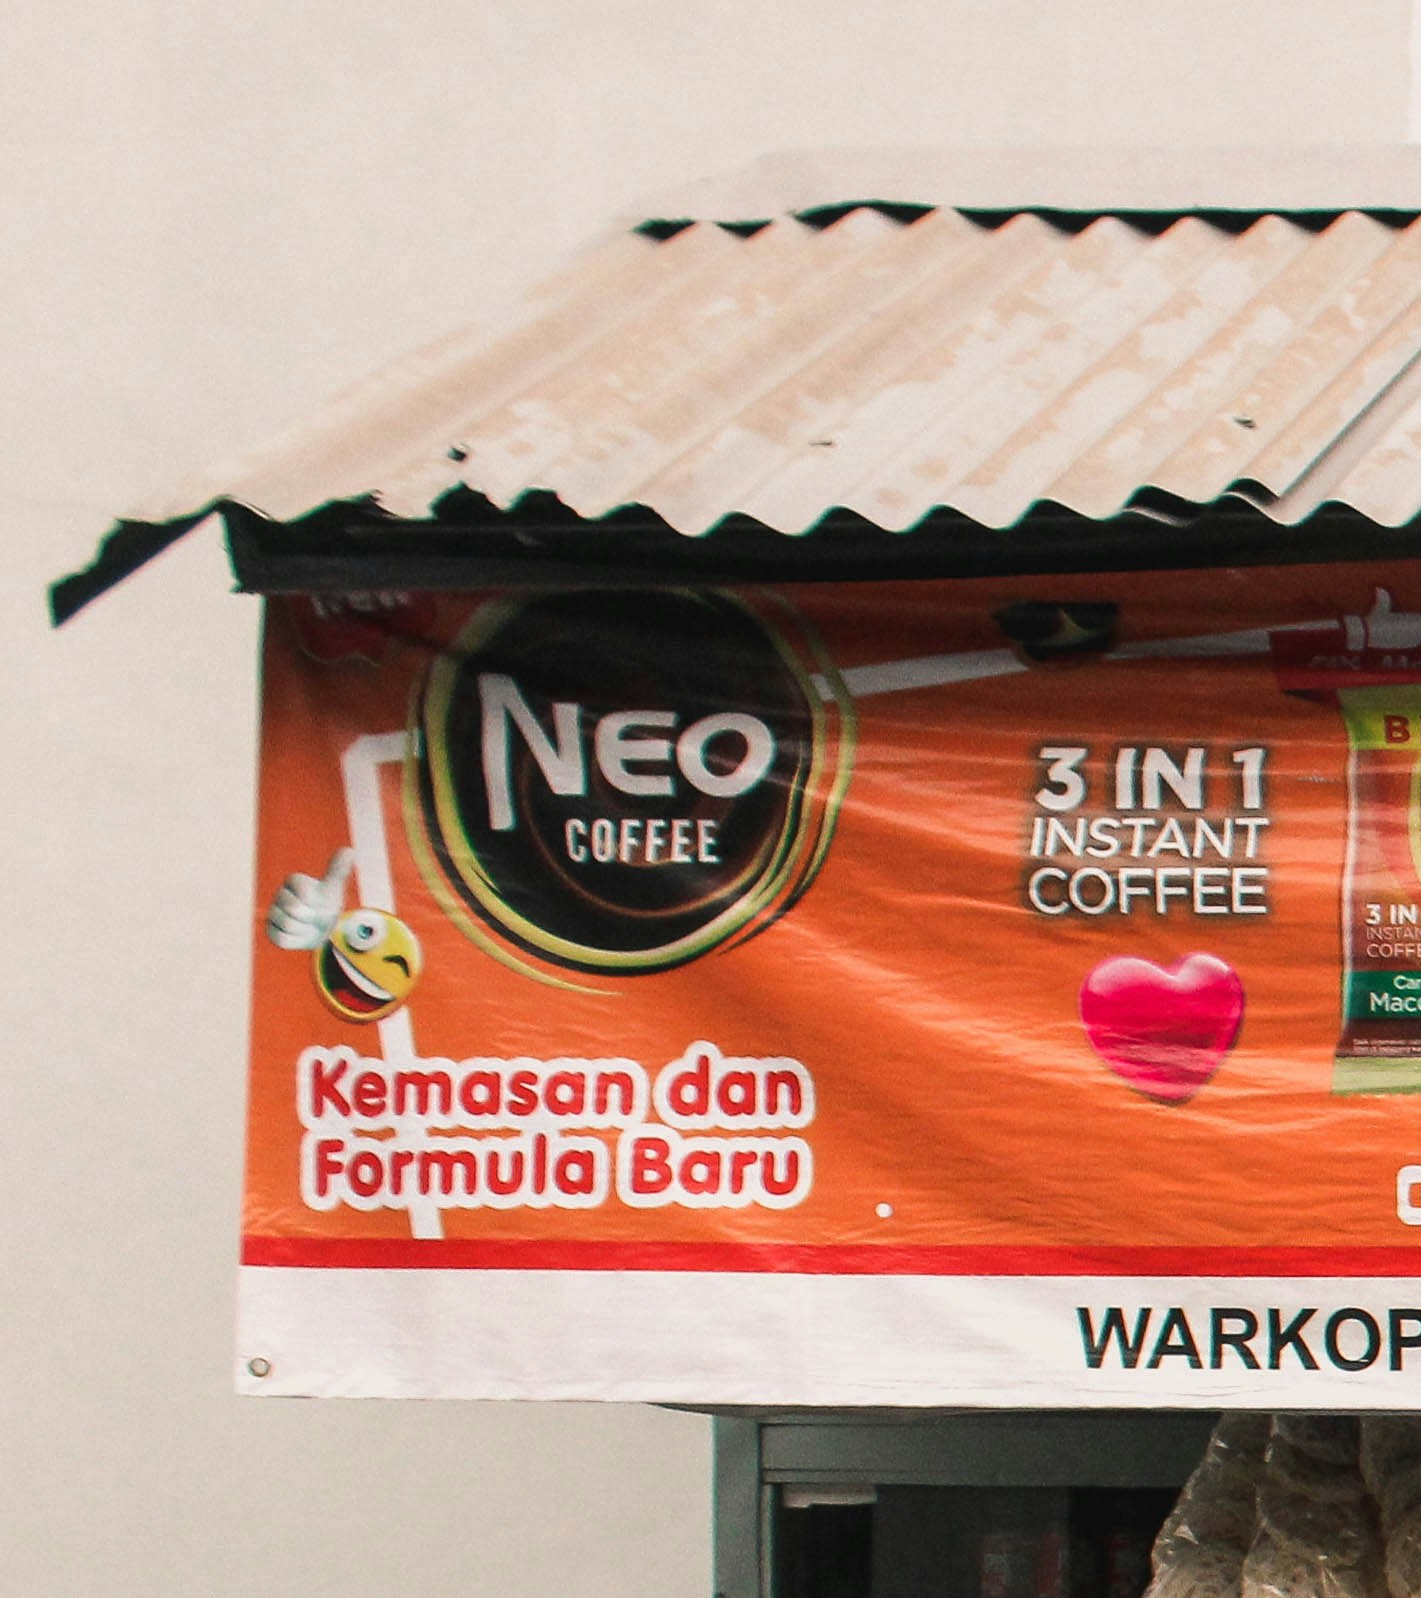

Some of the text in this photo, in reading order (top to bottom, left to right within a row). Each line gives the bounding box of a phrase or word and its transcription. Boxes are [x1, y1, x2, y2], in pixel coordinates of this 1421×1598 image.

[476, 671, 778, 832] NEO
[1035, 746, 1266, 811] 3 IN 1
[565, 818, 721, 864] COFFEE
[1029, 816, 1270, 859] INSTANT
[1028, 866, 1269, 916] COFFEE
[1365, 903, 1382, 926] 3
[1389, 903, 1418, 926] IN
[309, 1053, 803, 1119] Kemasan dan
[314, 1132, 800, 1197] Formula Baru
